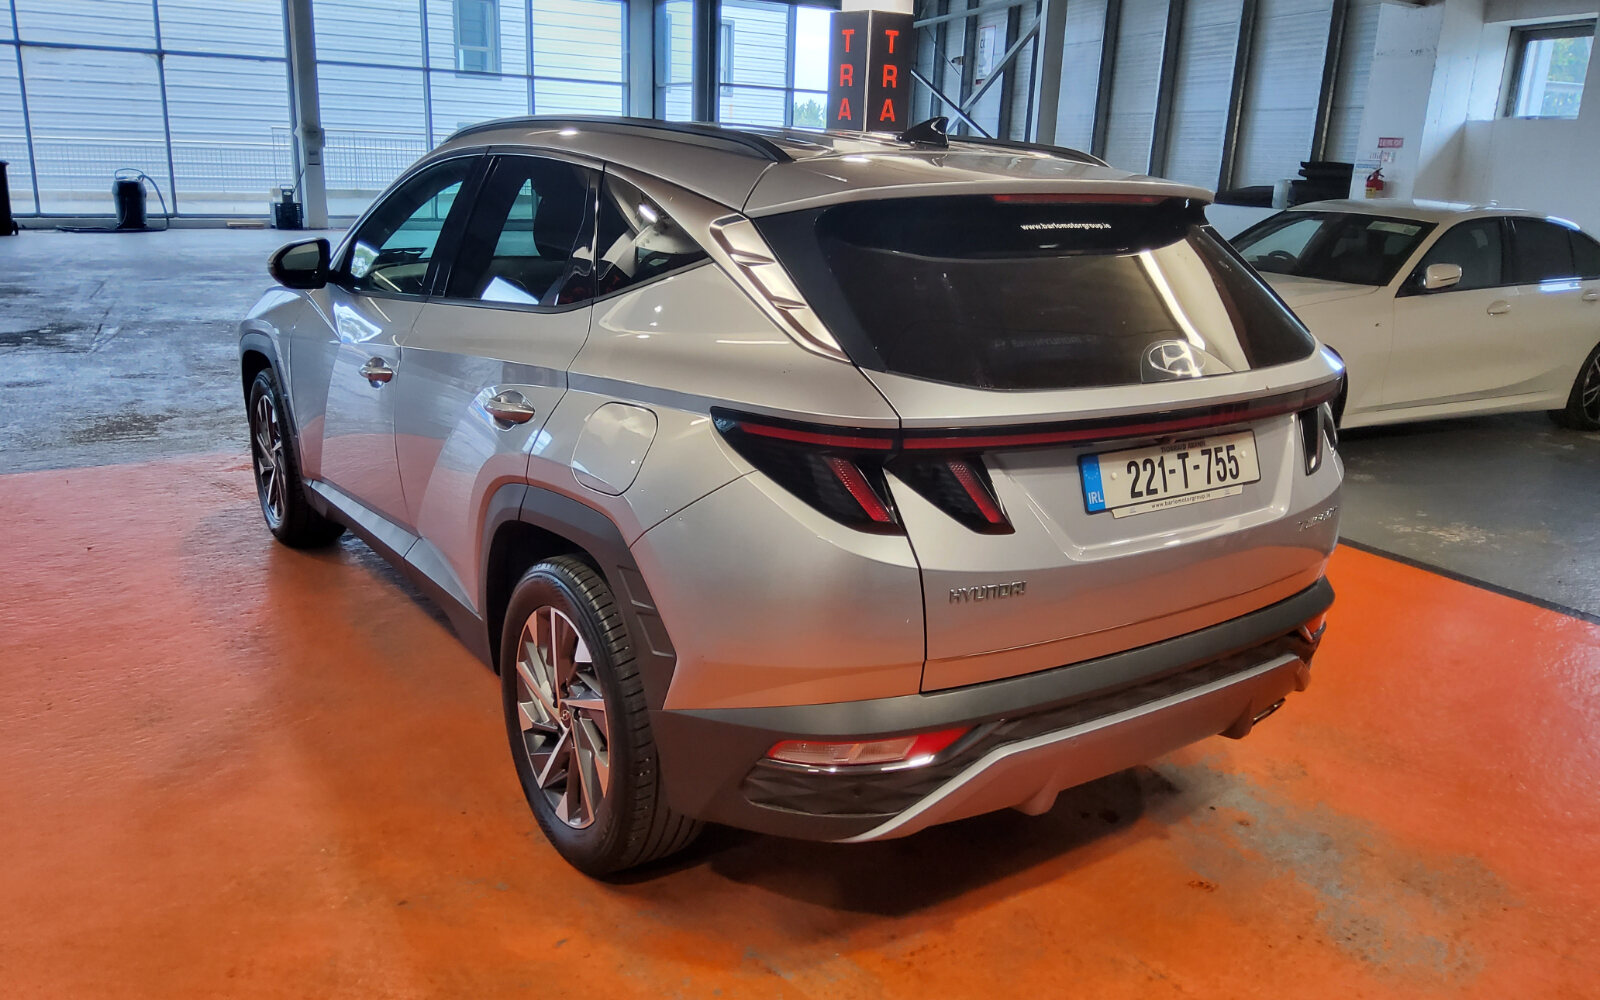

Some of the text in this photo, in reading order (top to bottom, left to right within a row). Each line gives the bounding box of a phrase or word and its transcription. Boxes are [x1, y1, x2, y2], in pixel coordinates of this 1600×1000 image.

[837, 28, 855, 121] TRA
[879, 29, 899, 122] TRA
[1088, 492, 1105, 505] IRL
[1126, 444, 1240, 499] 221-T-755
[949, 580, 1027, 603] HYUNDAI
